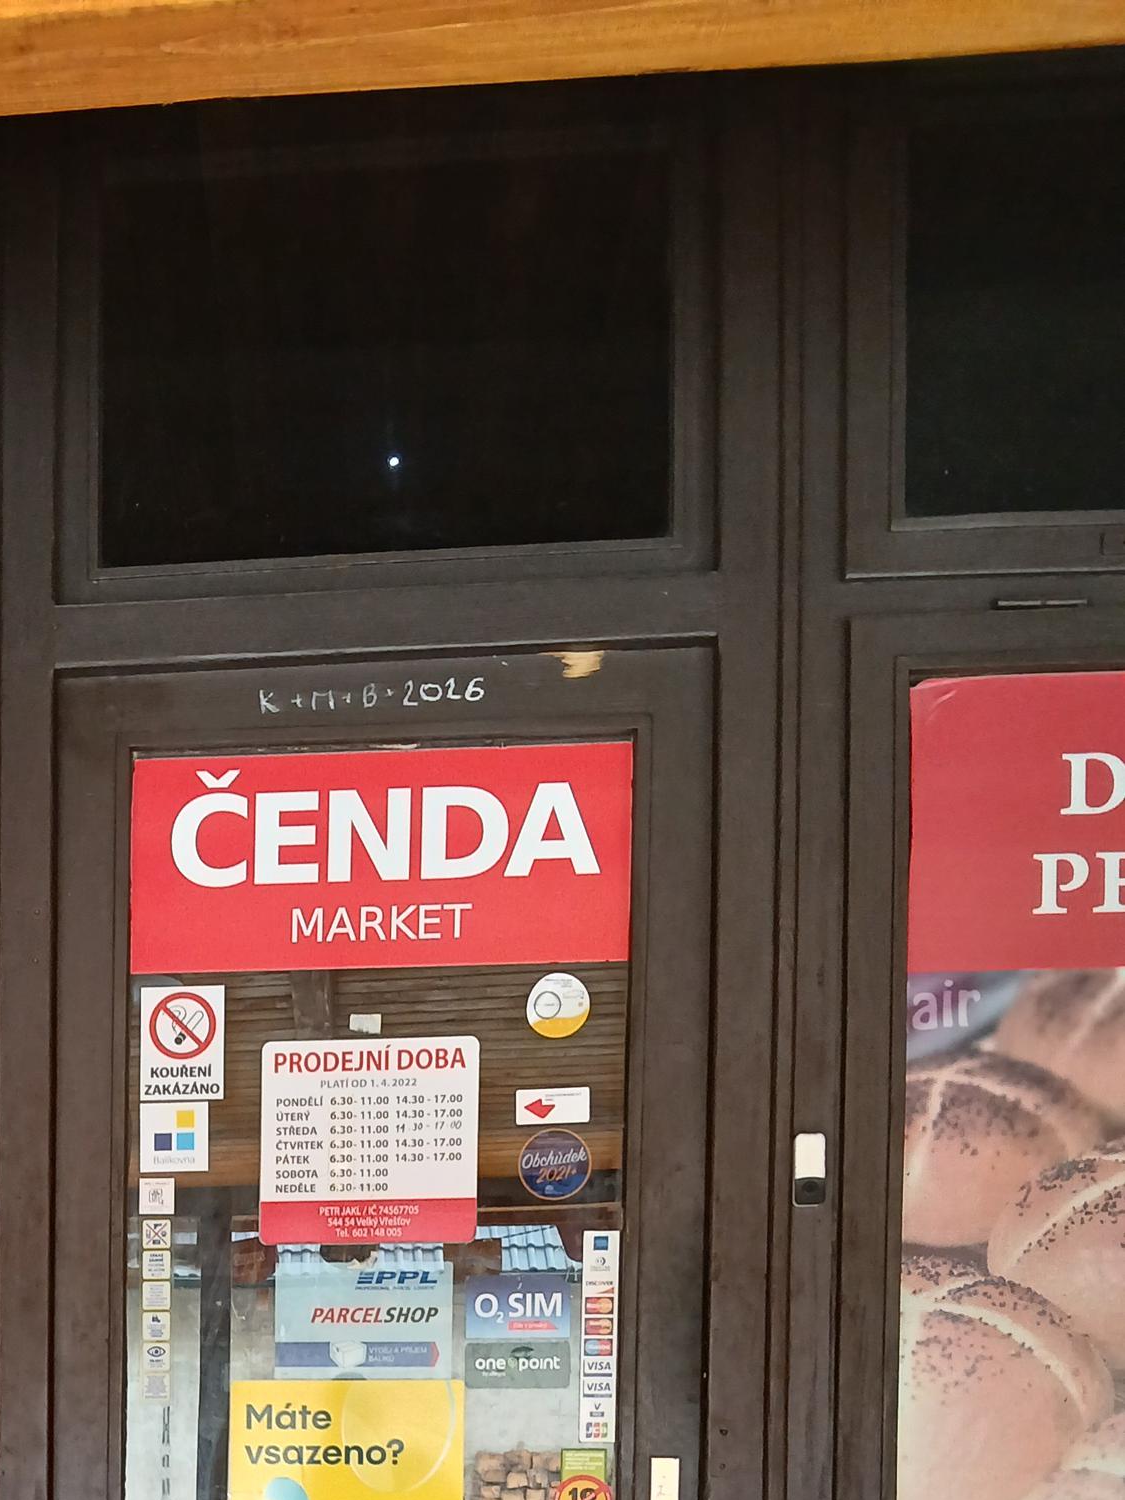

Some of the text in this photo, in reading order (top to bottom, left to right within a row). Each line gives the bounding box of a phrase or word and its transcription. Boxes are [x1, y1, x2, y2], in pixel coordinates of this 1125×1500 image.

[402, 677, 485, 707] 2026
[170, 768, 602, 888] ČENDA
[290, 902, 473, 944] MARKET
[907, 979, 981, 1031] air
[274, 1045, 466, 1073] PRODEJNÍ DOBA
[150, 1064, 212, 1079] KOUŘENÍ
[144, 1080, 220, 1096] ZAKÁZÁNO
[320, 1078, 349, 1089] PLATÍ
[351, 1079, 367, 1088] OD
[276, 1096, 323, 1107] PONDĚLÍ
[361, 1097, 389, 1105] 11.00
[396, 1096, 424, 1104] 14.30
[435, 1095, 463, 1103] 17.00
[276, 1111, 310, 1121] ÚTERÝ
[361, 1111, 389, 1119] 11.00
[396, 1110, 424, 1118] 14.30
[435, 1109, 463, 1117] 17.00
[276, 1126, 318, 1136] STŘEDA
[361, 1126, 389, 1134] 11.00
[275, 1140, 324, 1151] ČTVRTEK
[361, 1140, 389, 1148] 11.00
[395, 1139, 423, 1147] 14.30
[434, 1138, 462, 1146] 17.00
[275, 1155, 310, 1165] PÁTEK
[361, 1155, 389, 1163] 11.00
[395, 1153, 423, 1161] 14.30
[434, 1152, 462, 1160] 17.00
[275, 1170, 318, 1179] SOBOTA
[360, 1169, 388, 1177] 11.00
[275, 1184, 316, 1193] NEDĚLE
[360, 1183, 388, 1192] 11.00
[319, 1206, 340, 1216] PETR
[375, 1271, 438, 1284] PPL
[508, 1292, 562, 1318] SIM
[311, 1307, 439, 1323] PARCELSHOP
[587, 1362, 611, 1371] VISA
[587, 1383, 611, 1392] VISA
[245, 1402, 331, 1430] Máte
[245, 1438, 404, 1466] vsazeno?
